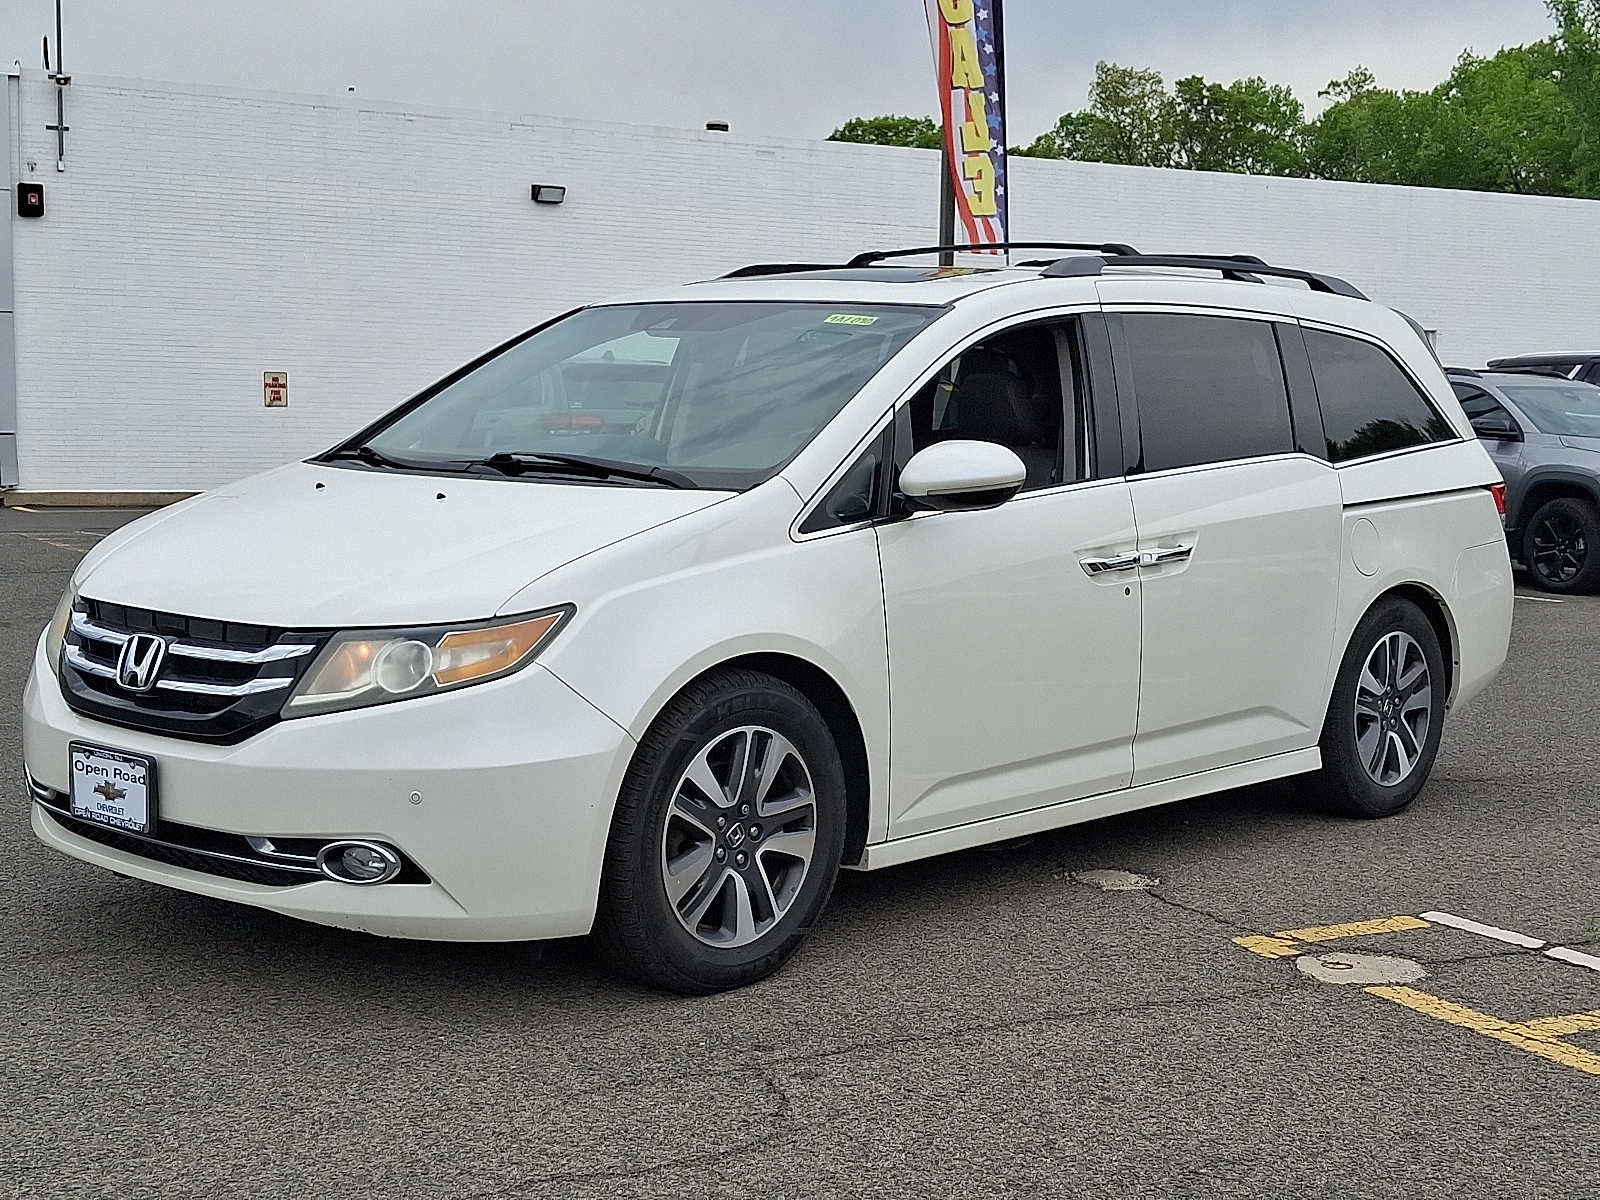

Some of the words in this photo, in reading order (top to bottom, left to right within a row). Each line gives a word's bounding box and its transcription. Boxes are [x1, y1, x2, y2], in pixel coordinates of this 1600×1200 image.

[74, 759, 109, 778] Open
[113, 767, 147, 786] Road
[74, 808, 91, 819] OPEN
[91, 811, 109, 823] ROAD
[109, 816, 144, 832] CHEVROLET
